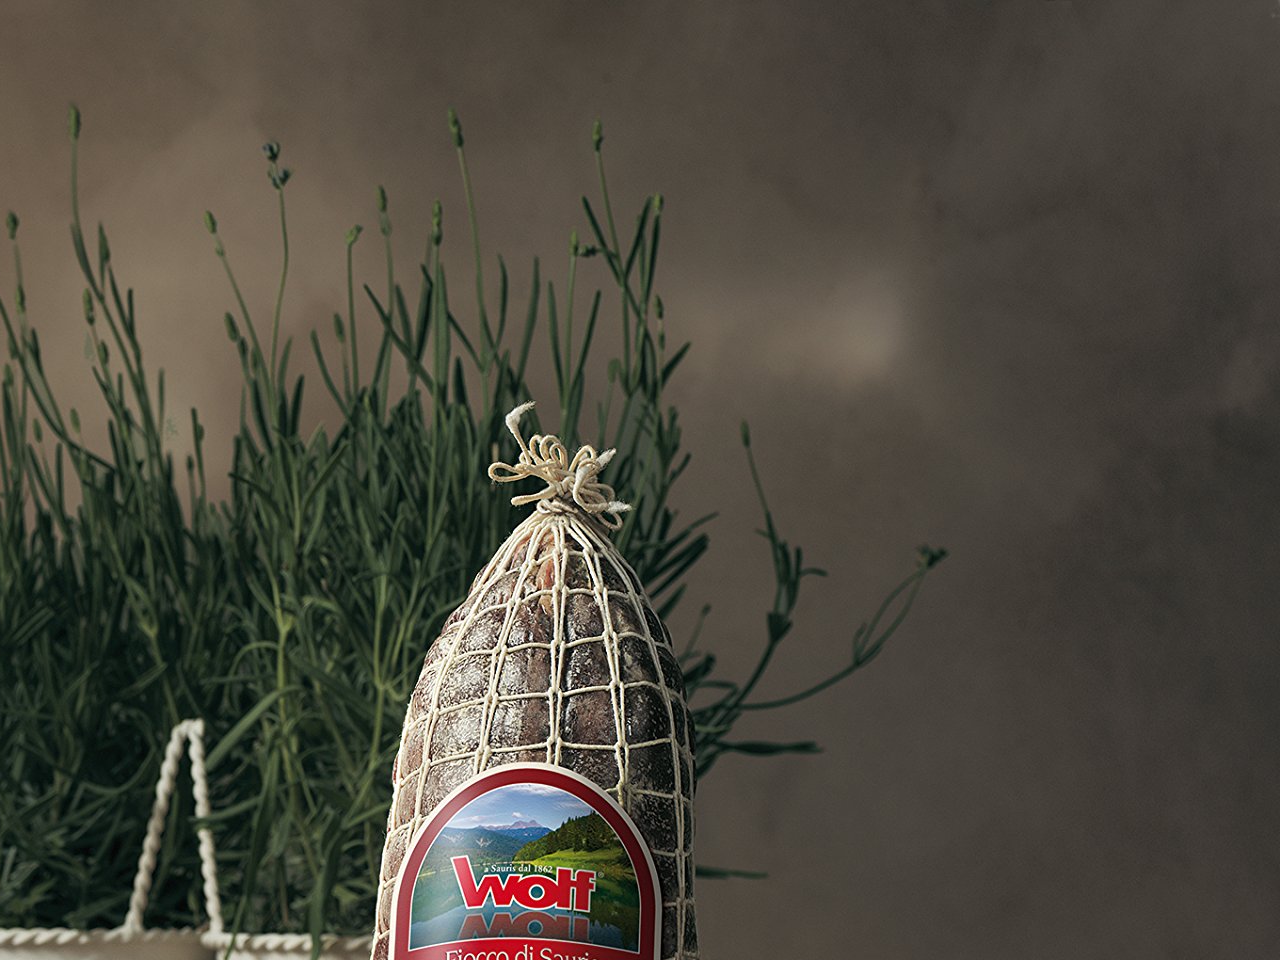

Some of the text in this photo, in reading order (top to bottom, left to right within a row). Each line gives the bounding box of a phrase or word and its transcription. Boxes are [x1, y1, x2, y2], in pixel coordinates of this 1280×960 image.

[450, 855, 596, 913] Wolf
[490, 864, 516, 873] Sauris
[518, 864, 531, 872] dal
[534, 865, 553, 873] 1862
